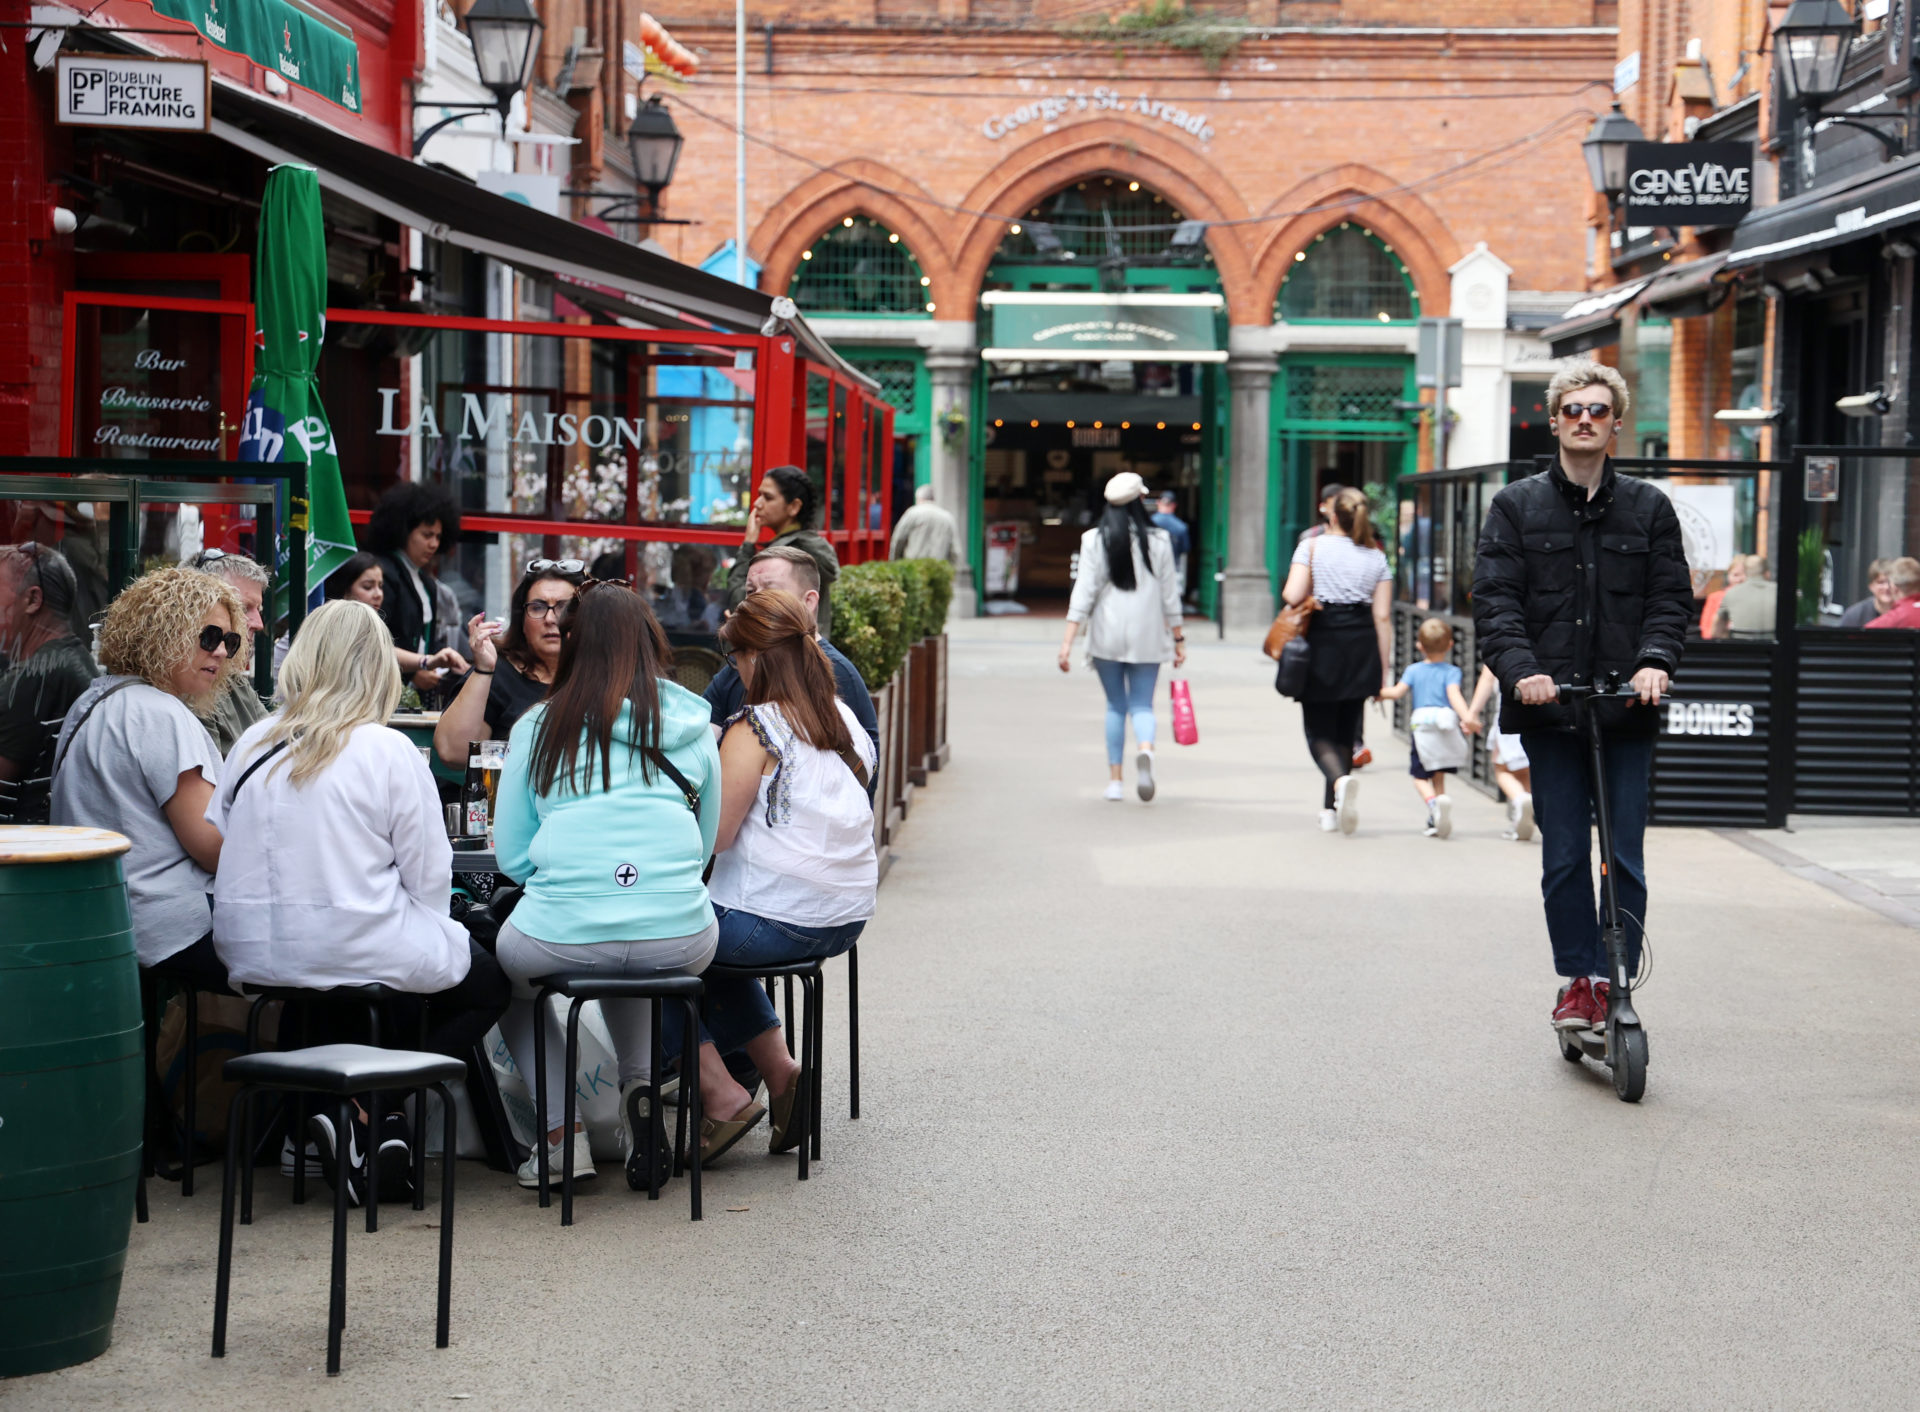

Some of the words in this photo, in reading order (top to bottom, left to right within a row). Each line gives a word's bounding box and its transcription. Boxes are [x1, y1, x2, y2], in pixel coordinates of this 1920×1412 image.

[73, 72, 103, 90] DP
[108, 71, 162, 86] DUBLIN
[109, 85, 183, 102] PICTURE
[109, 100, 196, 118] FRAMING
[983, 87, 1089, 140] George's
[1130, 92, 1216, 142] Arcade
[1628, 195, 1661, 206] NAIL
[1662, 194, 1694, 206] AND
[1695, 193, 1749, 206] BEAUTY
[134, 349, 187, 371] Bar
[100, 386, 211, 412] Brasserie
[458, 392, 645, 450] MAISON
[93, 425, 220, 451] Restaurant
[1667, 702, 1754, 736] BONES
